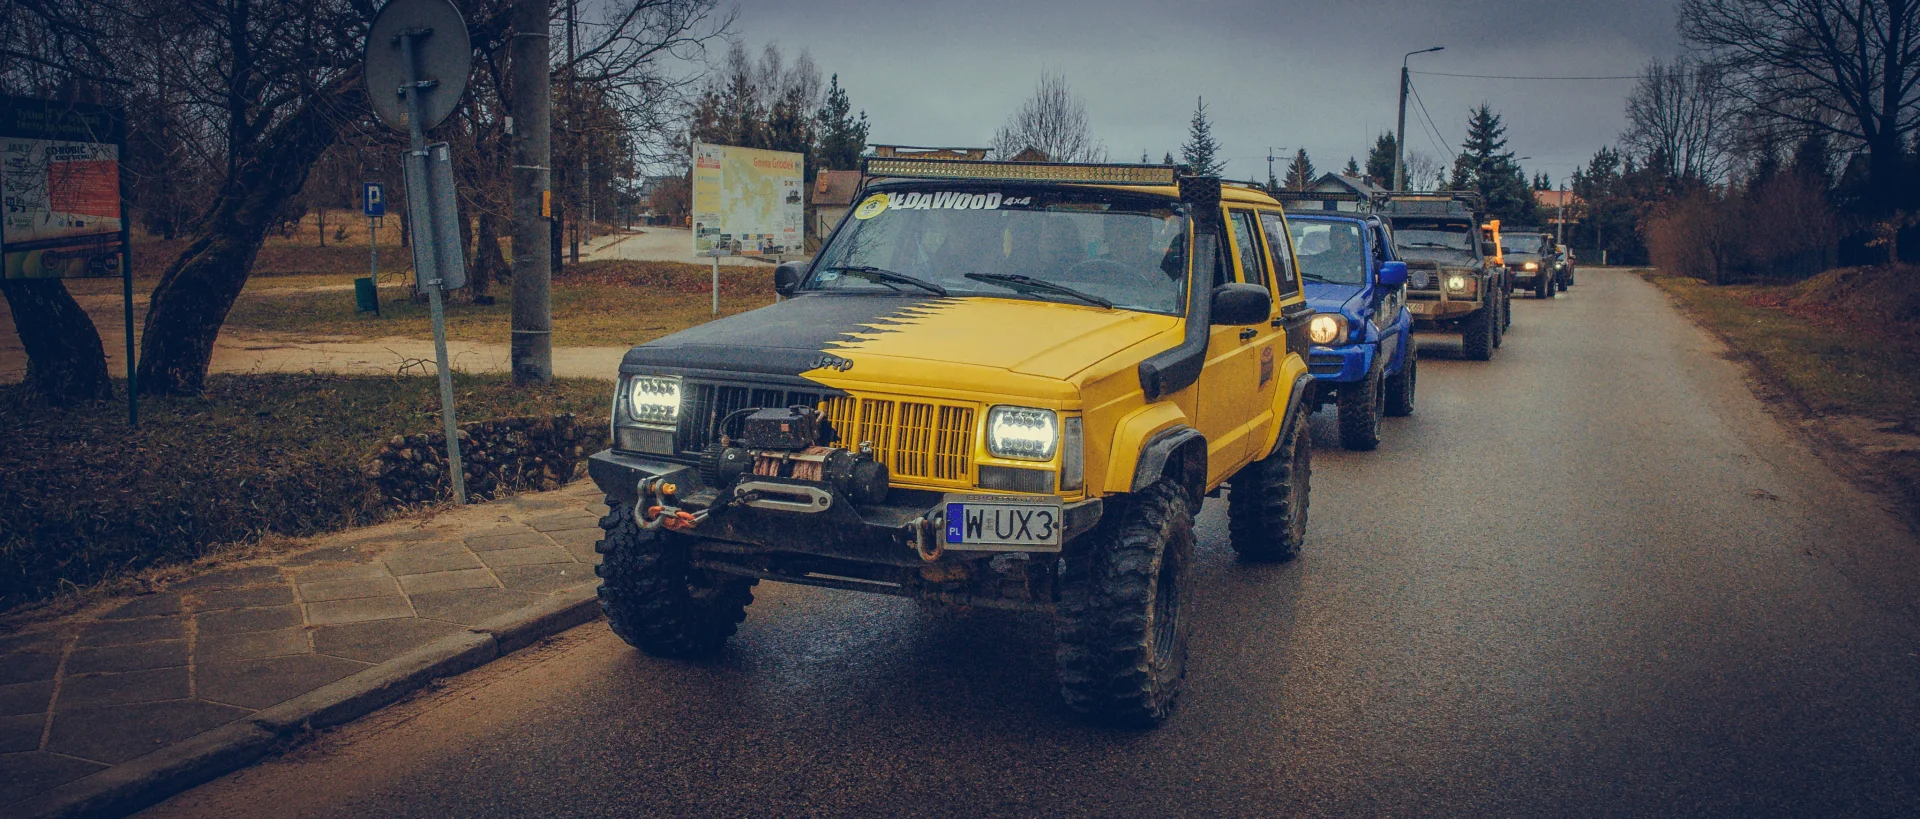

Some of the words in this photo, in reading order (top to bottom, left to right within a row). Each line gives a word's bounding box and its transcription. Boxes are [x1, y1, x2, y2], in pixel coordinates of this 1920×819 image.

[753, 157, 771, 168] Gmina
[772, 157, 794, 170] Gródek
[368, 185, 381, 211] P
[872, 191, 1002, 211] AŁDAWOOD
[949, 527, 961, 536] PL
[995, 509, 1053, 541] UX3
